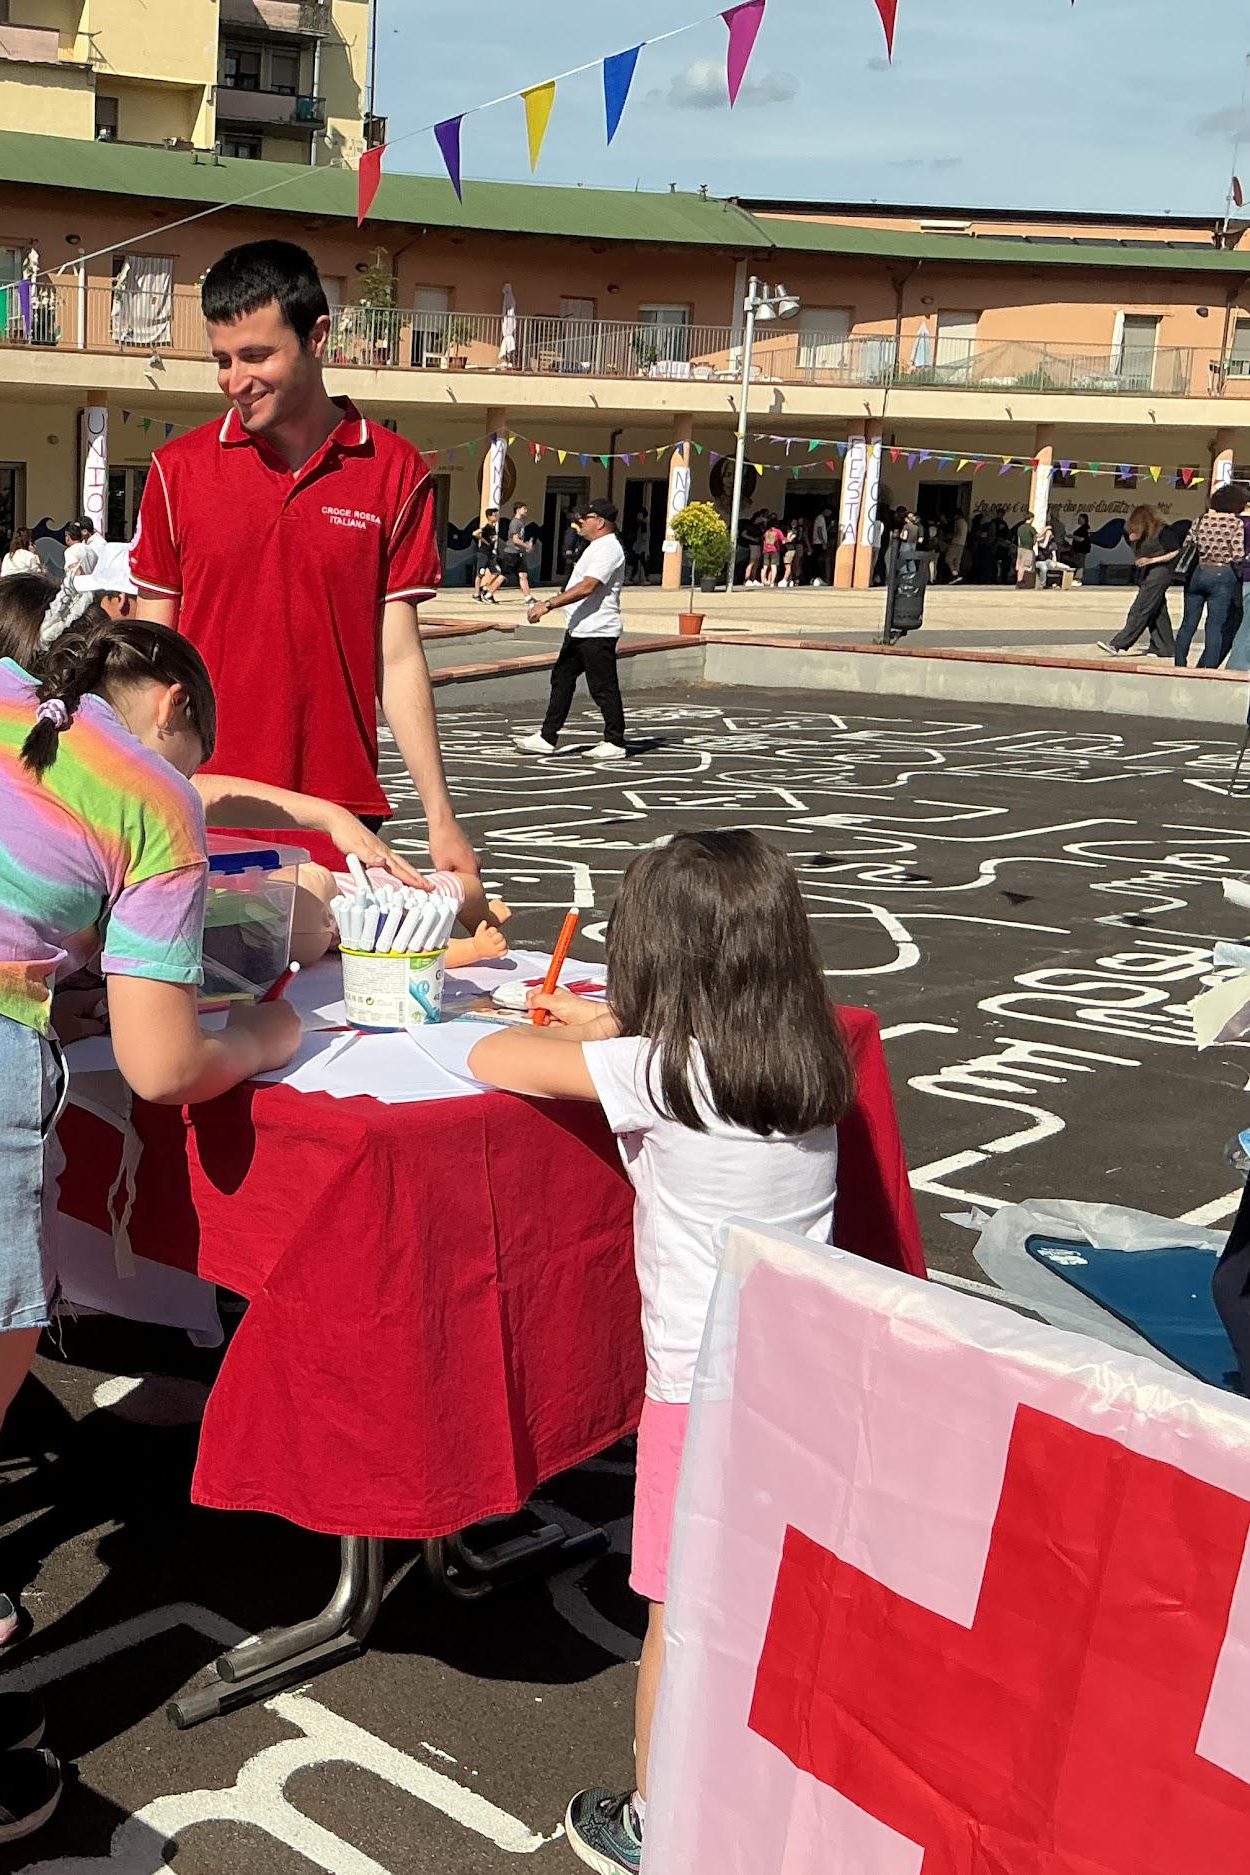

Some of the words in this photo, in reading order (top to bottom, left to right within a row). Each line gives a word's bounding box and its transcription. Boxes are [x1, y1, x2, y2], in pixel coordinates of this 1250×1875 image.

[842, 438, 865, 542] FESTA
[321, 506, 352, 517] CROCE
[353, 510, 381, 524] ROSSA
[330, 516, 367, 529] ITALIANA
